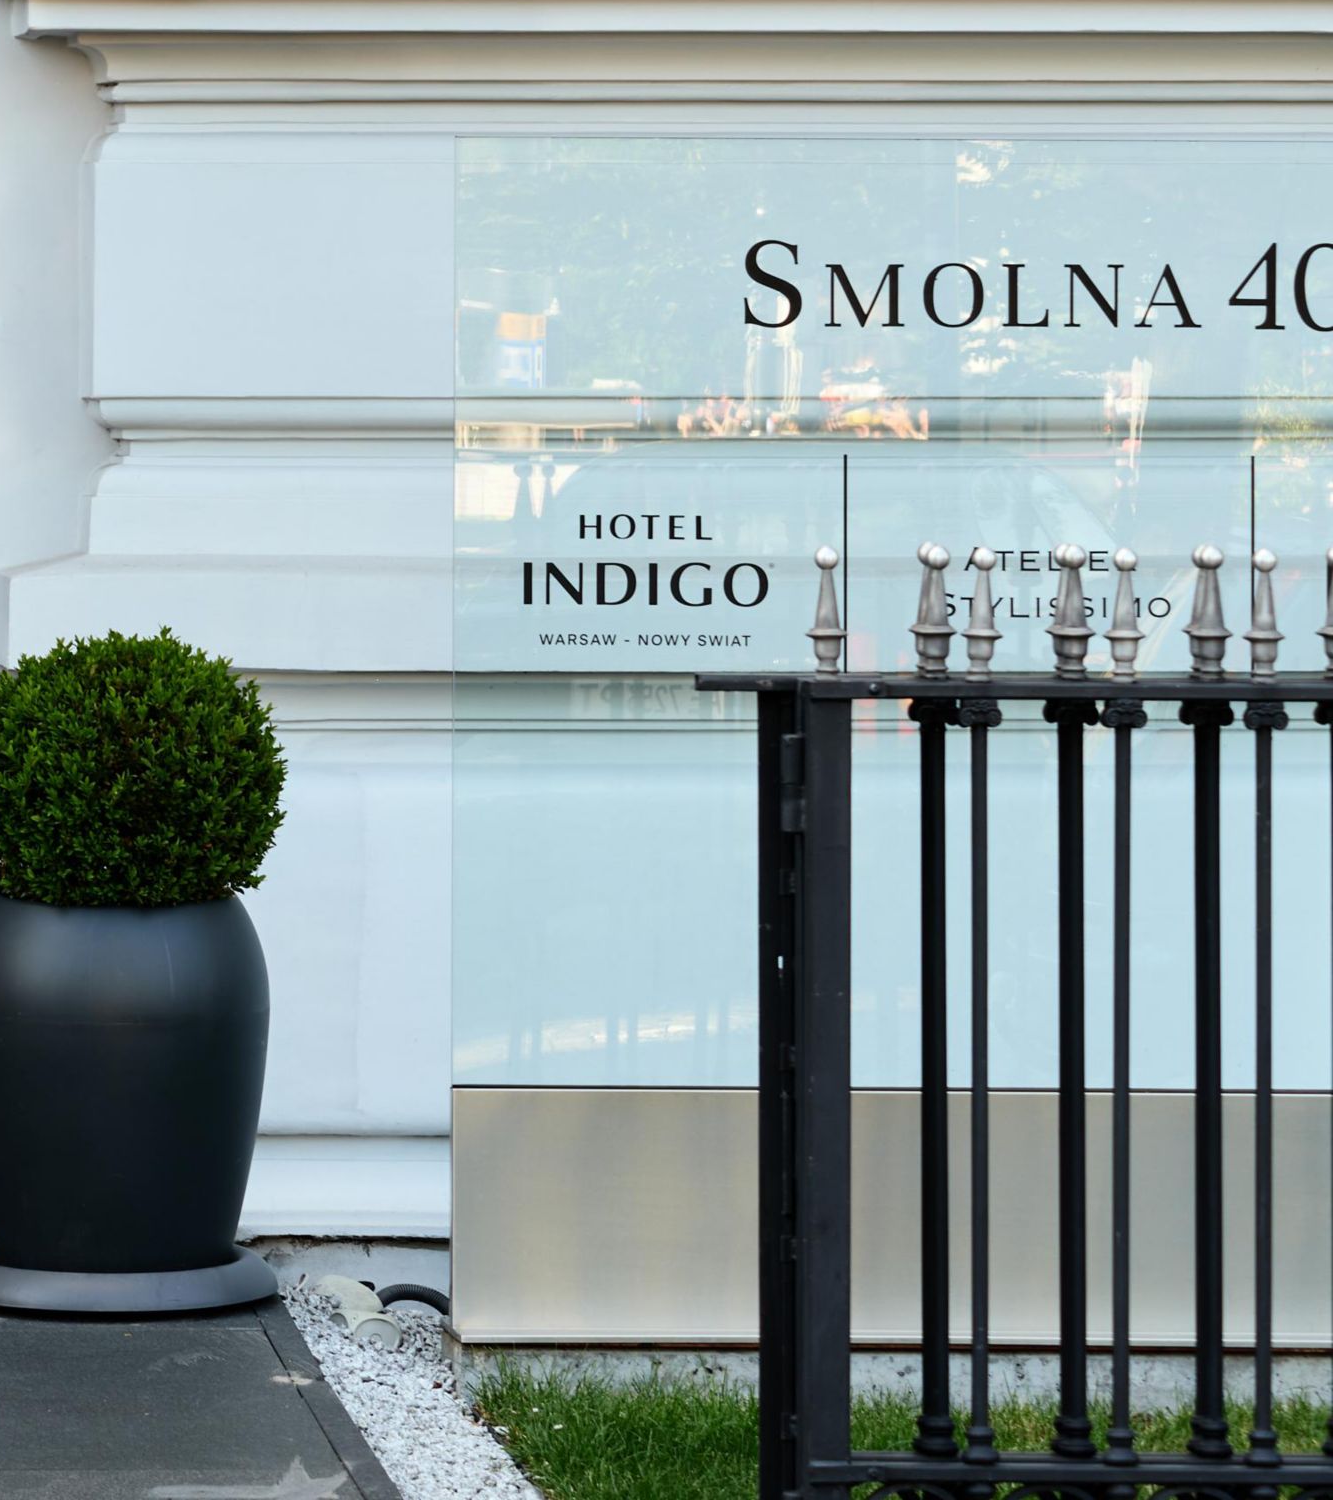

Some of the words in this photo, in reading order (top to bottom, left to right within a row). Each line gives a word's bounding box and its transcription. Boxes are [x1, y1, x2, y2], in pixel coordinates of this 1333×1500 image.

[743, 240, 1201, 329] SMOLNA
[1228, 242, 1333, 332] 40
[579, 513, 713, 541] HOTEL
[963, 546, 1137, 572] ATELE
[523, 562, 769, 608] INDIGO
[539, 633, 617, 646] WARSAW
[637, 634, 691, 647] NOWY
[697, 634, 752, 648] SWIAT
